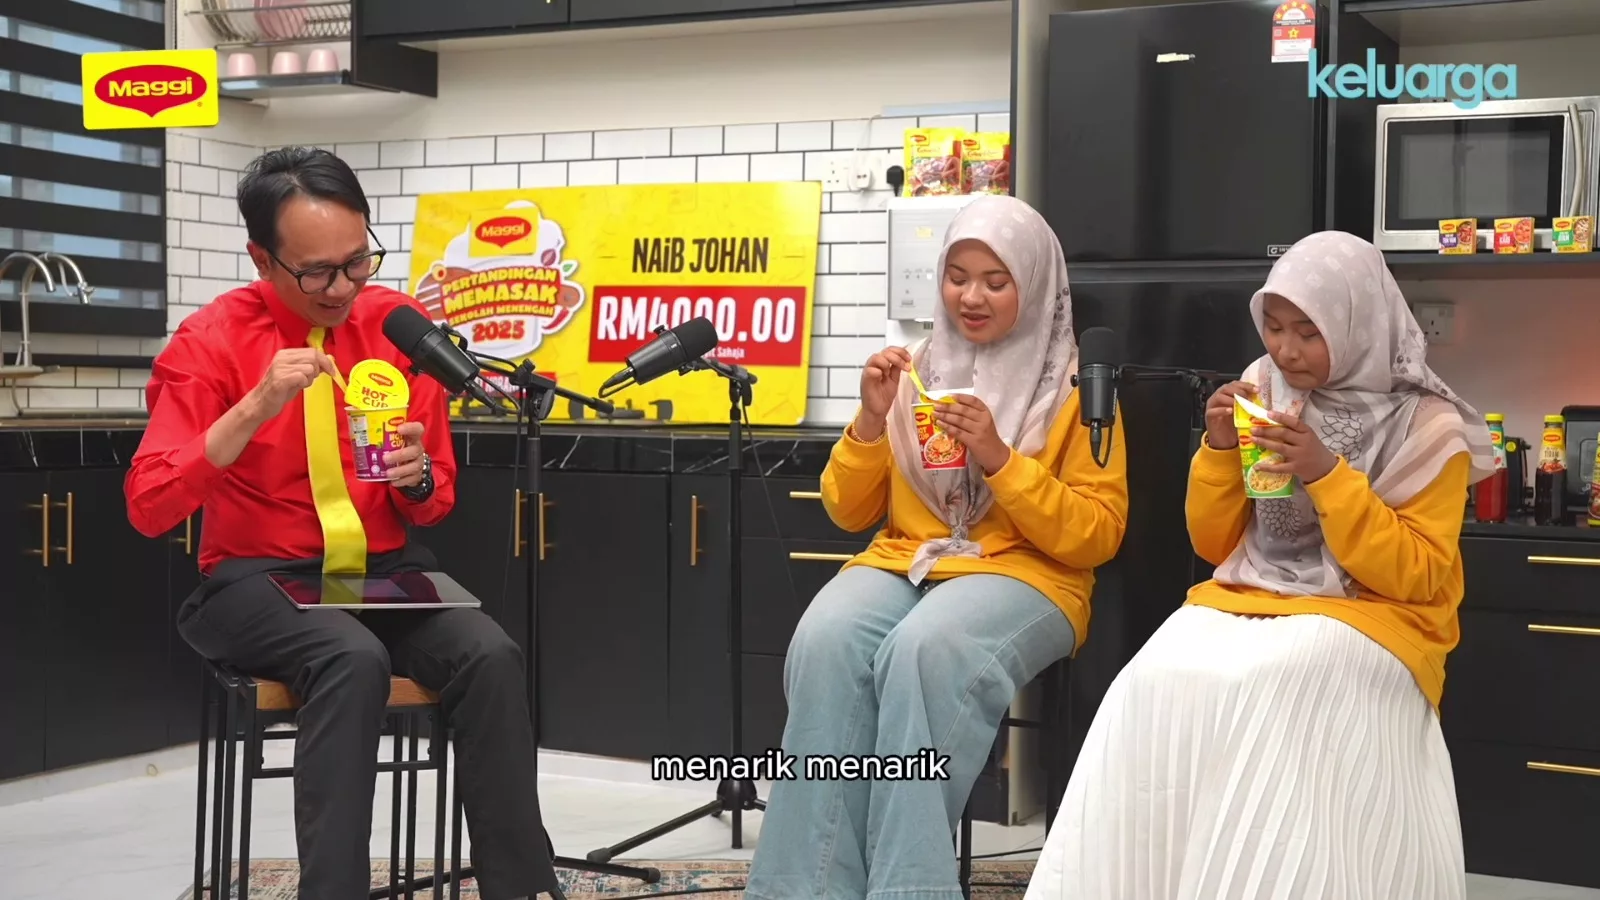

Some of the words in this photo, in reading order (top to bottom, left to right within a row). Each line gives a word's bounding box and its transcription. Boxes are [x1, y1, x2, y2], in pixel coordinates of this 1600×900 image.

[481, 223, 526, 241] Maggi
[689, 237, 769, 274] JOHAN
[442, 267, 558, 295] PERTANDINGAN
[443, 282, 558, 315] MEMASAK
[448, 306, 494, 326] SEKOLAH
[496, 303, 555, 317] MENENGAH
[472, 319, 525, 343] 2025
[717, 346, 745, 360] Sahaja
[361, 386, 389, 400] HOT
